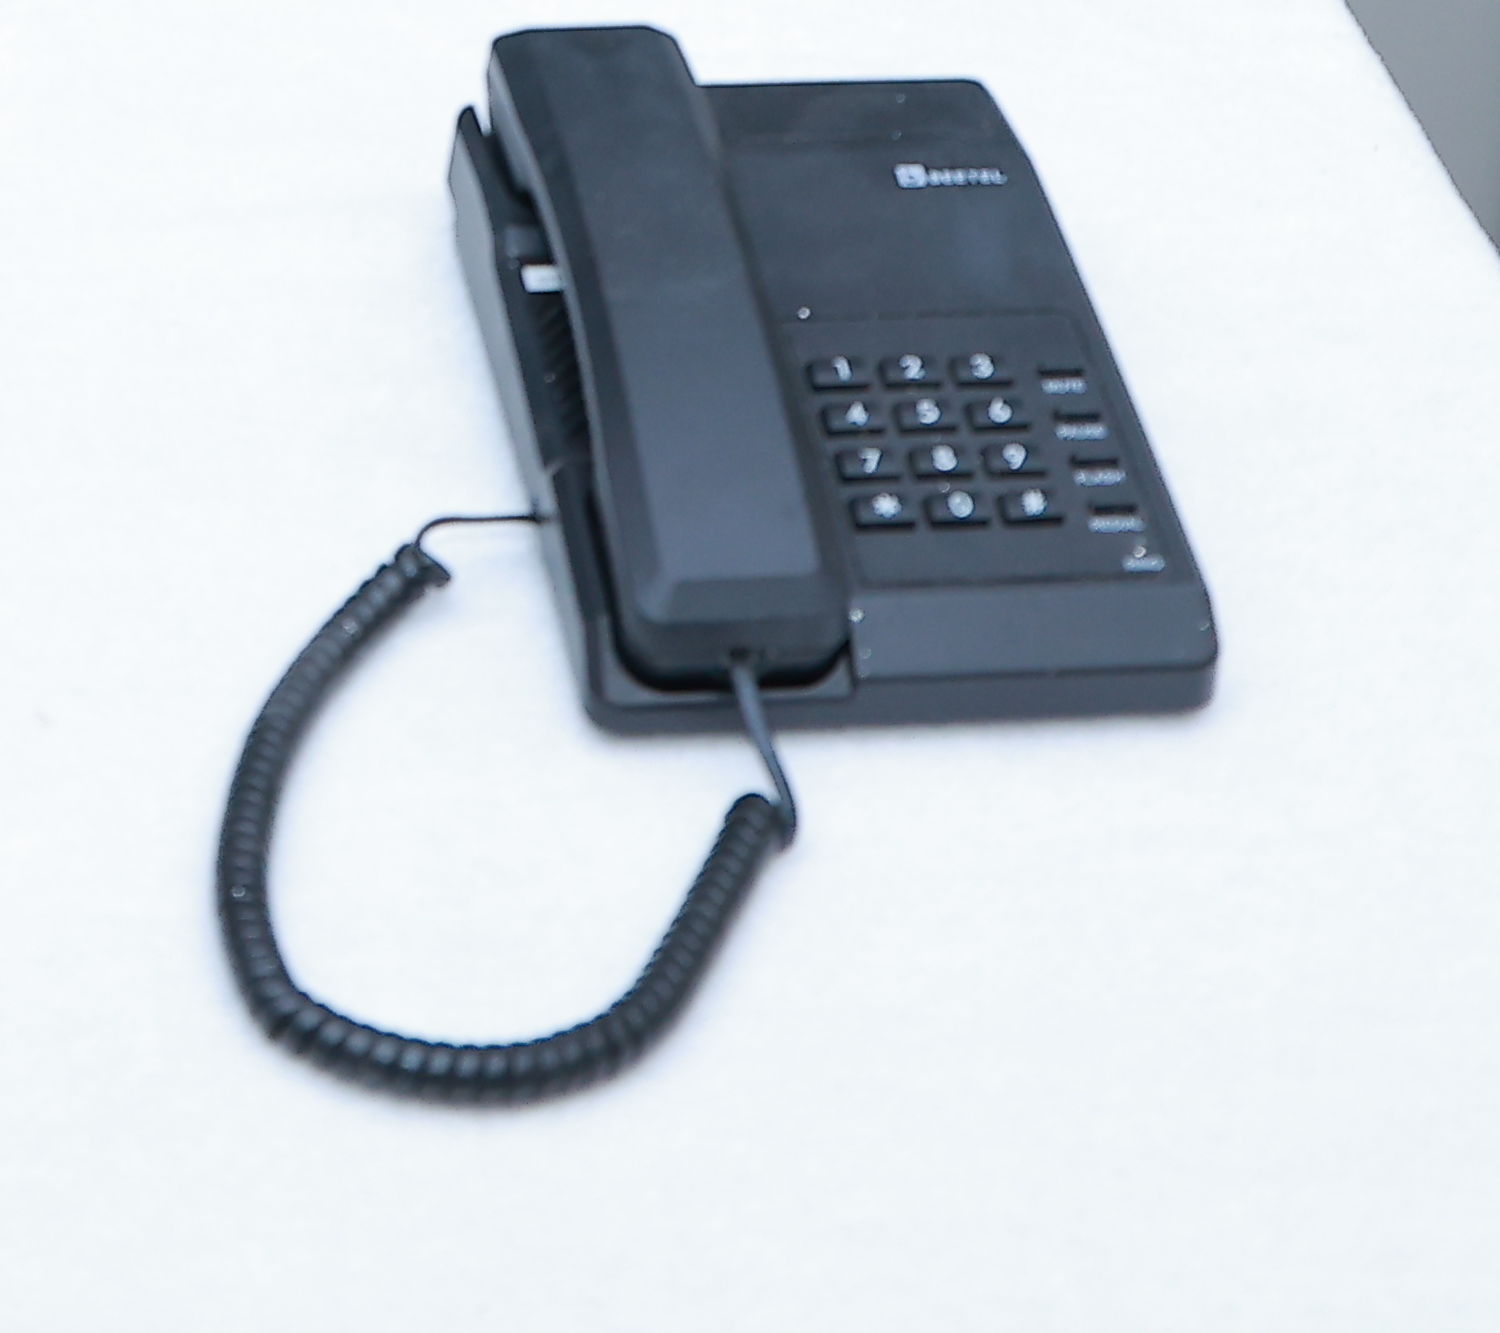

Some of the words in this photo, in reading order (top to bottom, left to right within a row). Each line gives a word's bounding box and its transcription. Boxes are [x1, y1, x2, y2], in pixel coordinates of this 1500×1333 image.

[834, 356, 852, 381] 1
[901, 354, 925, 379] 2
[971, 352, 994, 379] 3
[846, 401, 869, 426] 4
[916, 397, 941, 424] 5
[988, 397, 1012, 423] 6
[860, 447, 881, 474] 7
[932, 444, 958, 471] 8
[1002, 442, 1027, 470] 9
